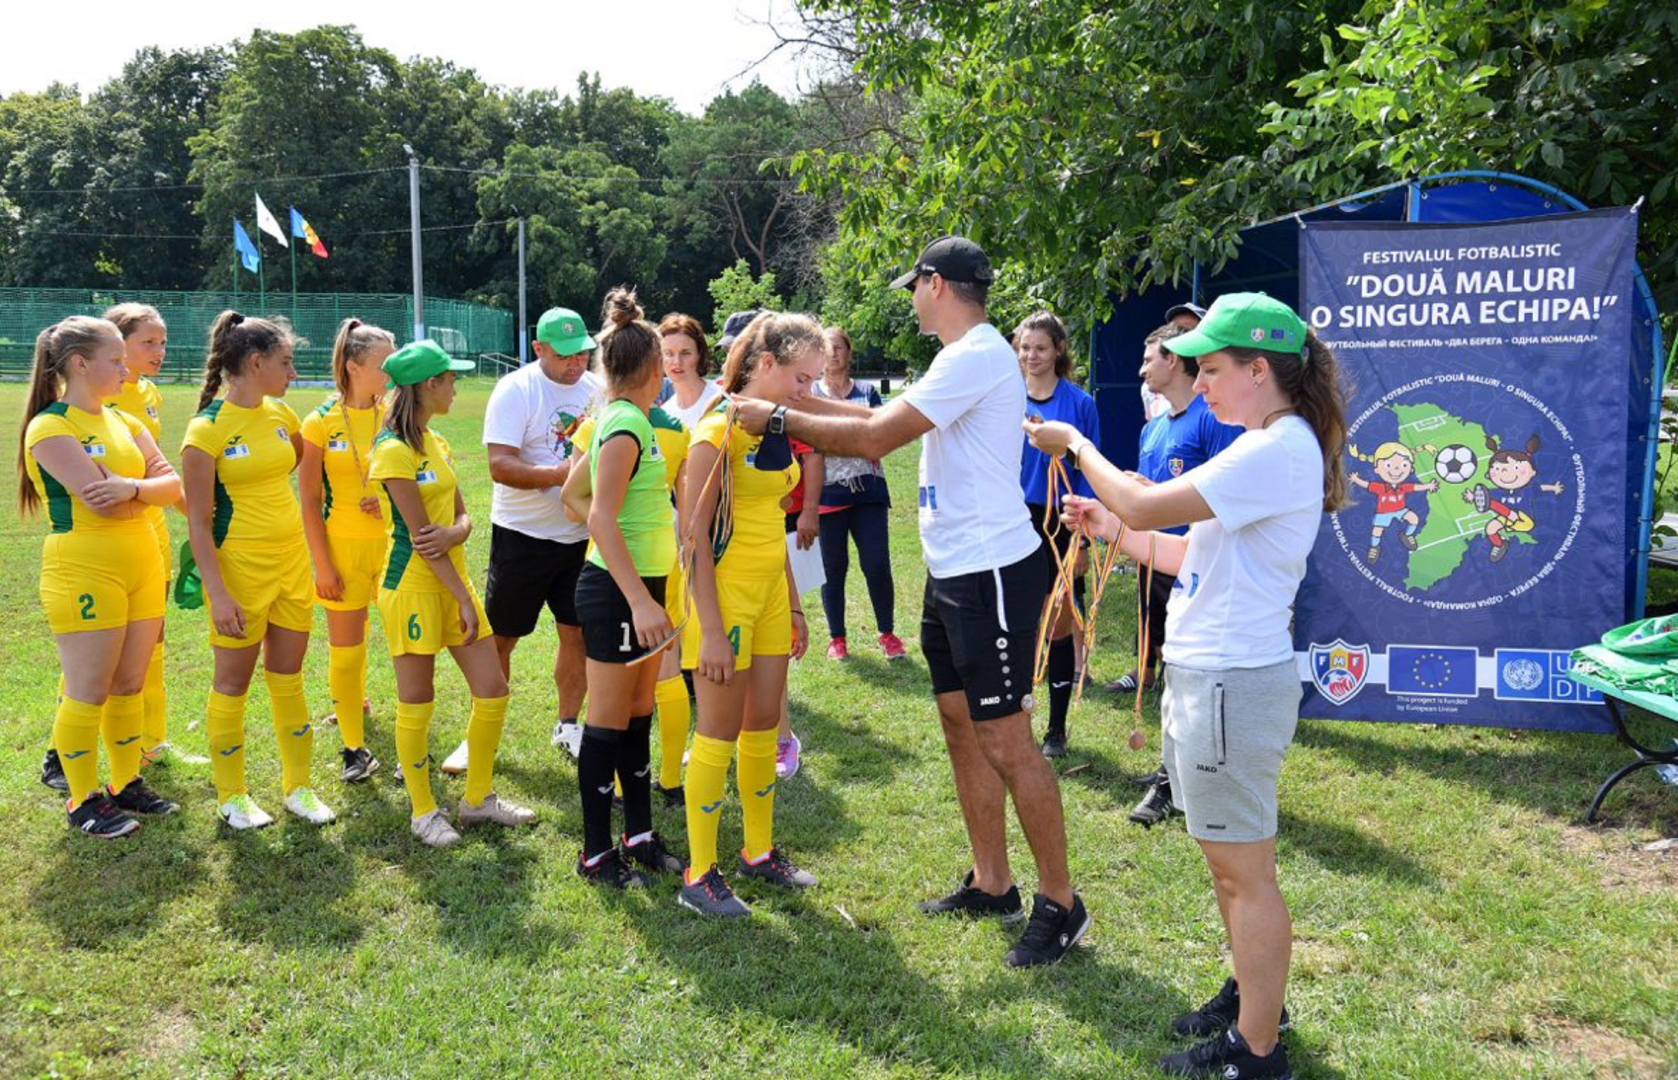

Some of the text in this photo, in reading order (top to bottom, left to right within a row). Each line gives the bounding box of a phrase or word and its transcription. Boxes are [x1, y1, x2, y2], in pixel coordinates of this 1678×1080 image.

[1363, 243, 1562, 265] FESTIVALUL FOTBALISTIC
[1455, 266, 1576, 294] MALURI
[1311, 309, 1331, 329] O
[1339, 301, 1471, 328] SINGURA
[1388, 338, 1443, 348] ФЕСТИВАЛЬ
[1469, 336, 1503, 346] БЕРЕГА
[1511, 336, 1539, 346] ОДНА
[1346, 400, 1384, 438] FESTIVALUL
[1382, 376, 1434, 403] FOTBALISTIC
[1466, 374, 1500, 388] MALURI
[1506, 384, 1515, 392] O
[1514, 387, 1549, 415] SINGURA
[1572, 453, 1586, 513] ФУТБОЛЬНЫЙ
[1330, 511, 1341, 530] BAN
[1553, 514, 1583, 561] ФЕСТИВАЛЬ
[1348, 550, 1376, 582] FESTIVAL
[1375, 577, 1415, 603] FOOTBALL
[1508, 576, 1540, 597] БЕРЕГА
[79, 593, 96, 620] 2
[1477, 595, 1504, 608] ОДНА
[408, 613, 422, 641] 6
[619, 622, 632, 651] 1
[727, 625, 740, 656] 4
[980, 695, 1001, 706] JAKO
[1196, 763, 1218, 773] JAKO
